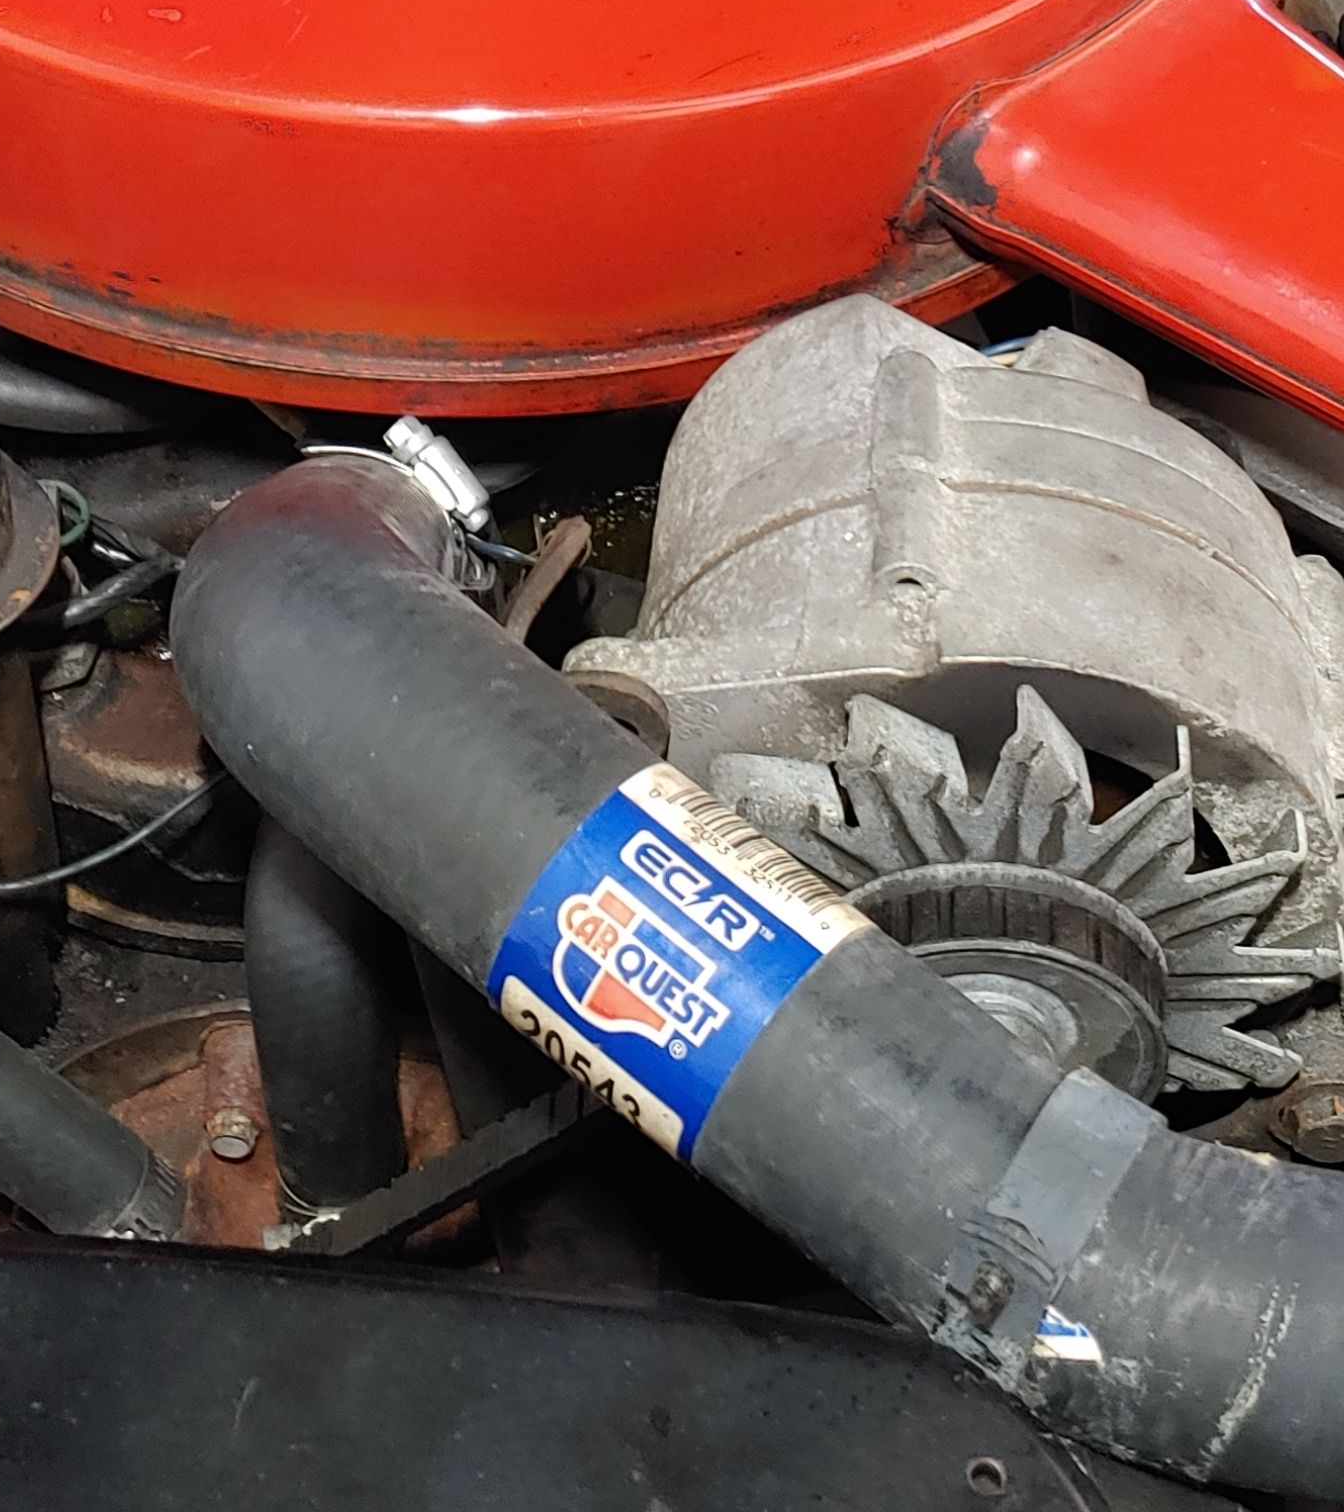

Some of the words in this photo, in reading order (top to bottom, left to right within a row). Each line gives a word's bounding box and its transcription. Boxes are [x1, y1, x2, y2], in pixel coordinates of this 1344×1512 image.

[565, 902, 619, 960] CAR
[615, 943, 719, 1037] QUEST
[520, 1009, 642, 1131] 20543
